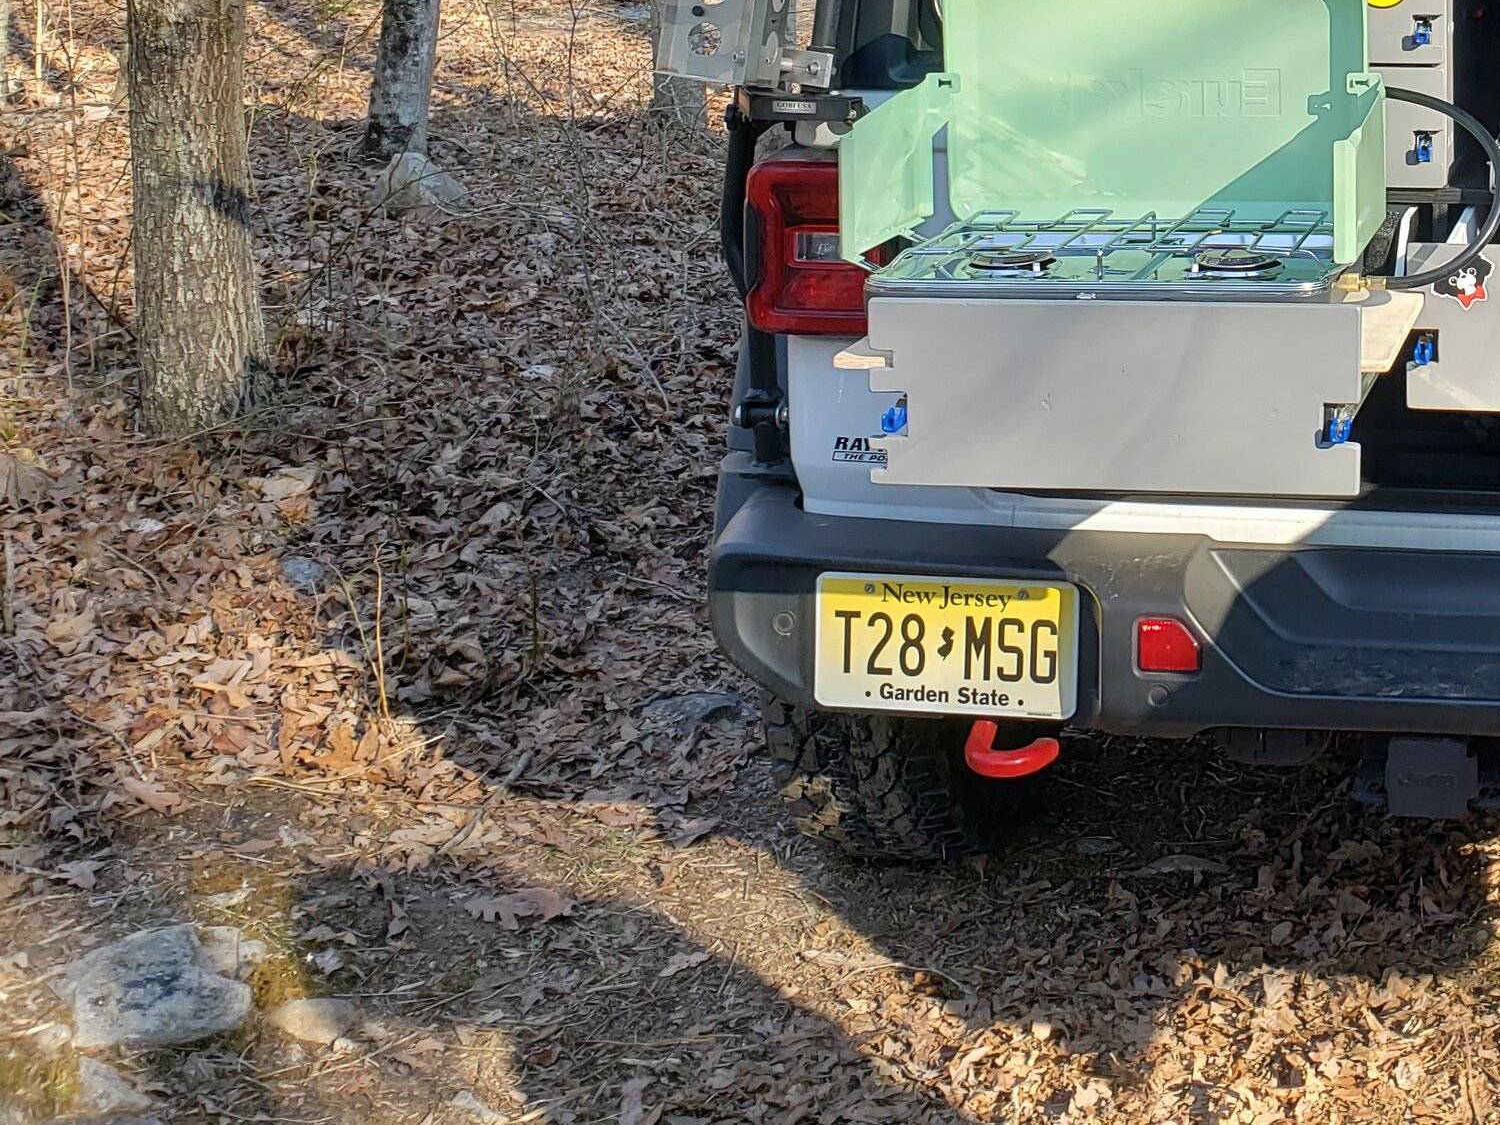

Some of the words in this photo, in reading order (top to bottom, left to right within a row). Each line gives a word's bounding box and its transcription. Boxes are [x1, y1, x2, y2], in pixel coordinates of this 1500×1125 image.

[843, 453, 866, 462] THE
[881, 582, 937, 605] New
[939, 585, 1012, 613] Jersey
[834, 609, 926, 677] T28
[963, 615, 1058, 685] MSG
[879, 682, 949, 703] Garden
[957, 686, 1010, 706] State
